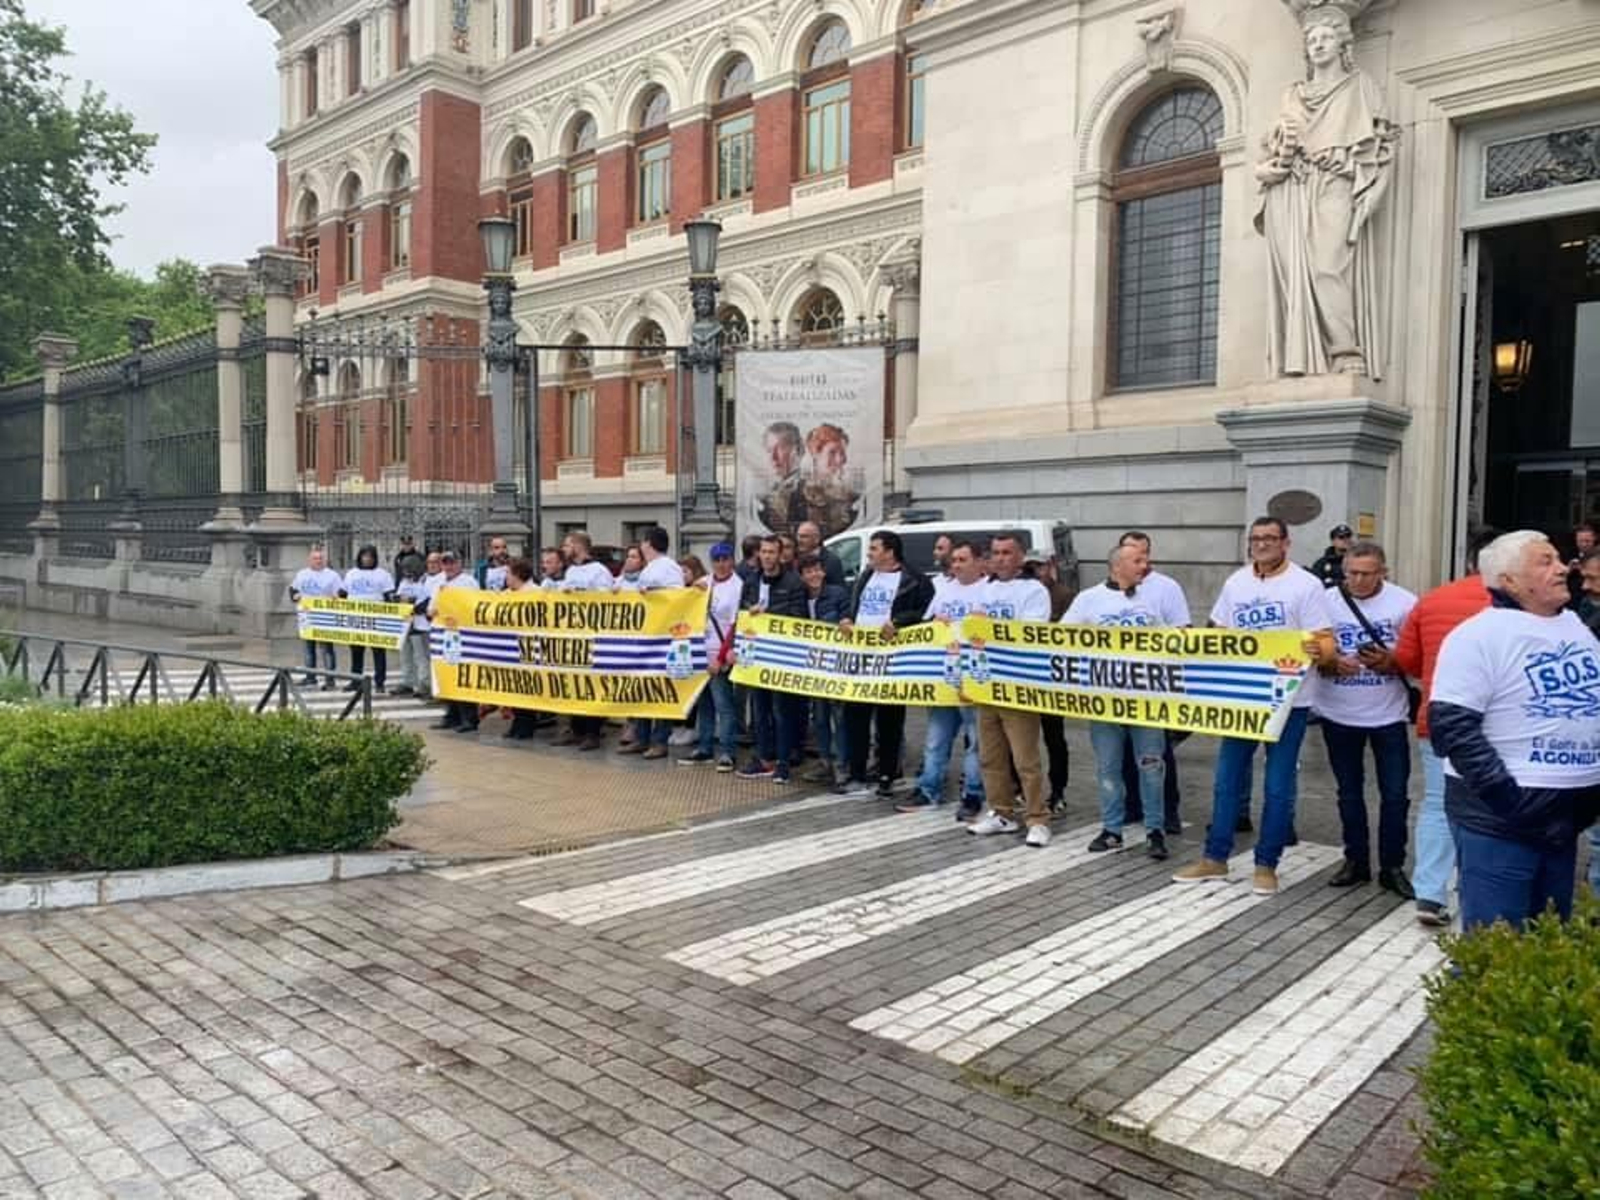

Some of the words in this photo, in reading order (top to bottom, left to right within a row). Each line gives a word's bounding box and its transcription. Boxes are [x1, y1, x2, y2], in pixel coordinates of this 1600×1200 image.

[474, 601, 490, 625] EL
[493, 601, 547, 627] SECTOR
[554, 601, 646, 632] PESQUERO
[769, 619, 787, 635] EL
[792, 622, 854, 645] SECTOR
[1237, 606, 1281, 628] S.O.S.
[518, 635, 535, 664] SE
[540, 637, 592, 667] MUERE
[993, 623, 1016, 643] EL
[1023, 625, 1111, 649] SECTOR
[1120, 630, 1259, 656] PESQUERO
[806, 647, 828, 671] SE
[835, 649, 893, 677] MUERE
[1050, 655, 1080, 684] SE
[1090, 658, 1185, 694] MUERE
[457, 663, 471, 688] EL
[477, 666, 544, 696] ENTIERRO
[547, 672, 570, 699] DE
[573, 674, 596, 701] LA
[600, 676, 680, 703] SARDINA
[759, 668, 849, 695] QUEREMOS
[851, 681, 936, 701] TRABAJAR
[991, 682, 1011, 702] EL
[1015, 685, 1105, 715] ENTIERRO
[1112, 698, 1137, 719] DE
[1145, 700, 1170, 723] LA
